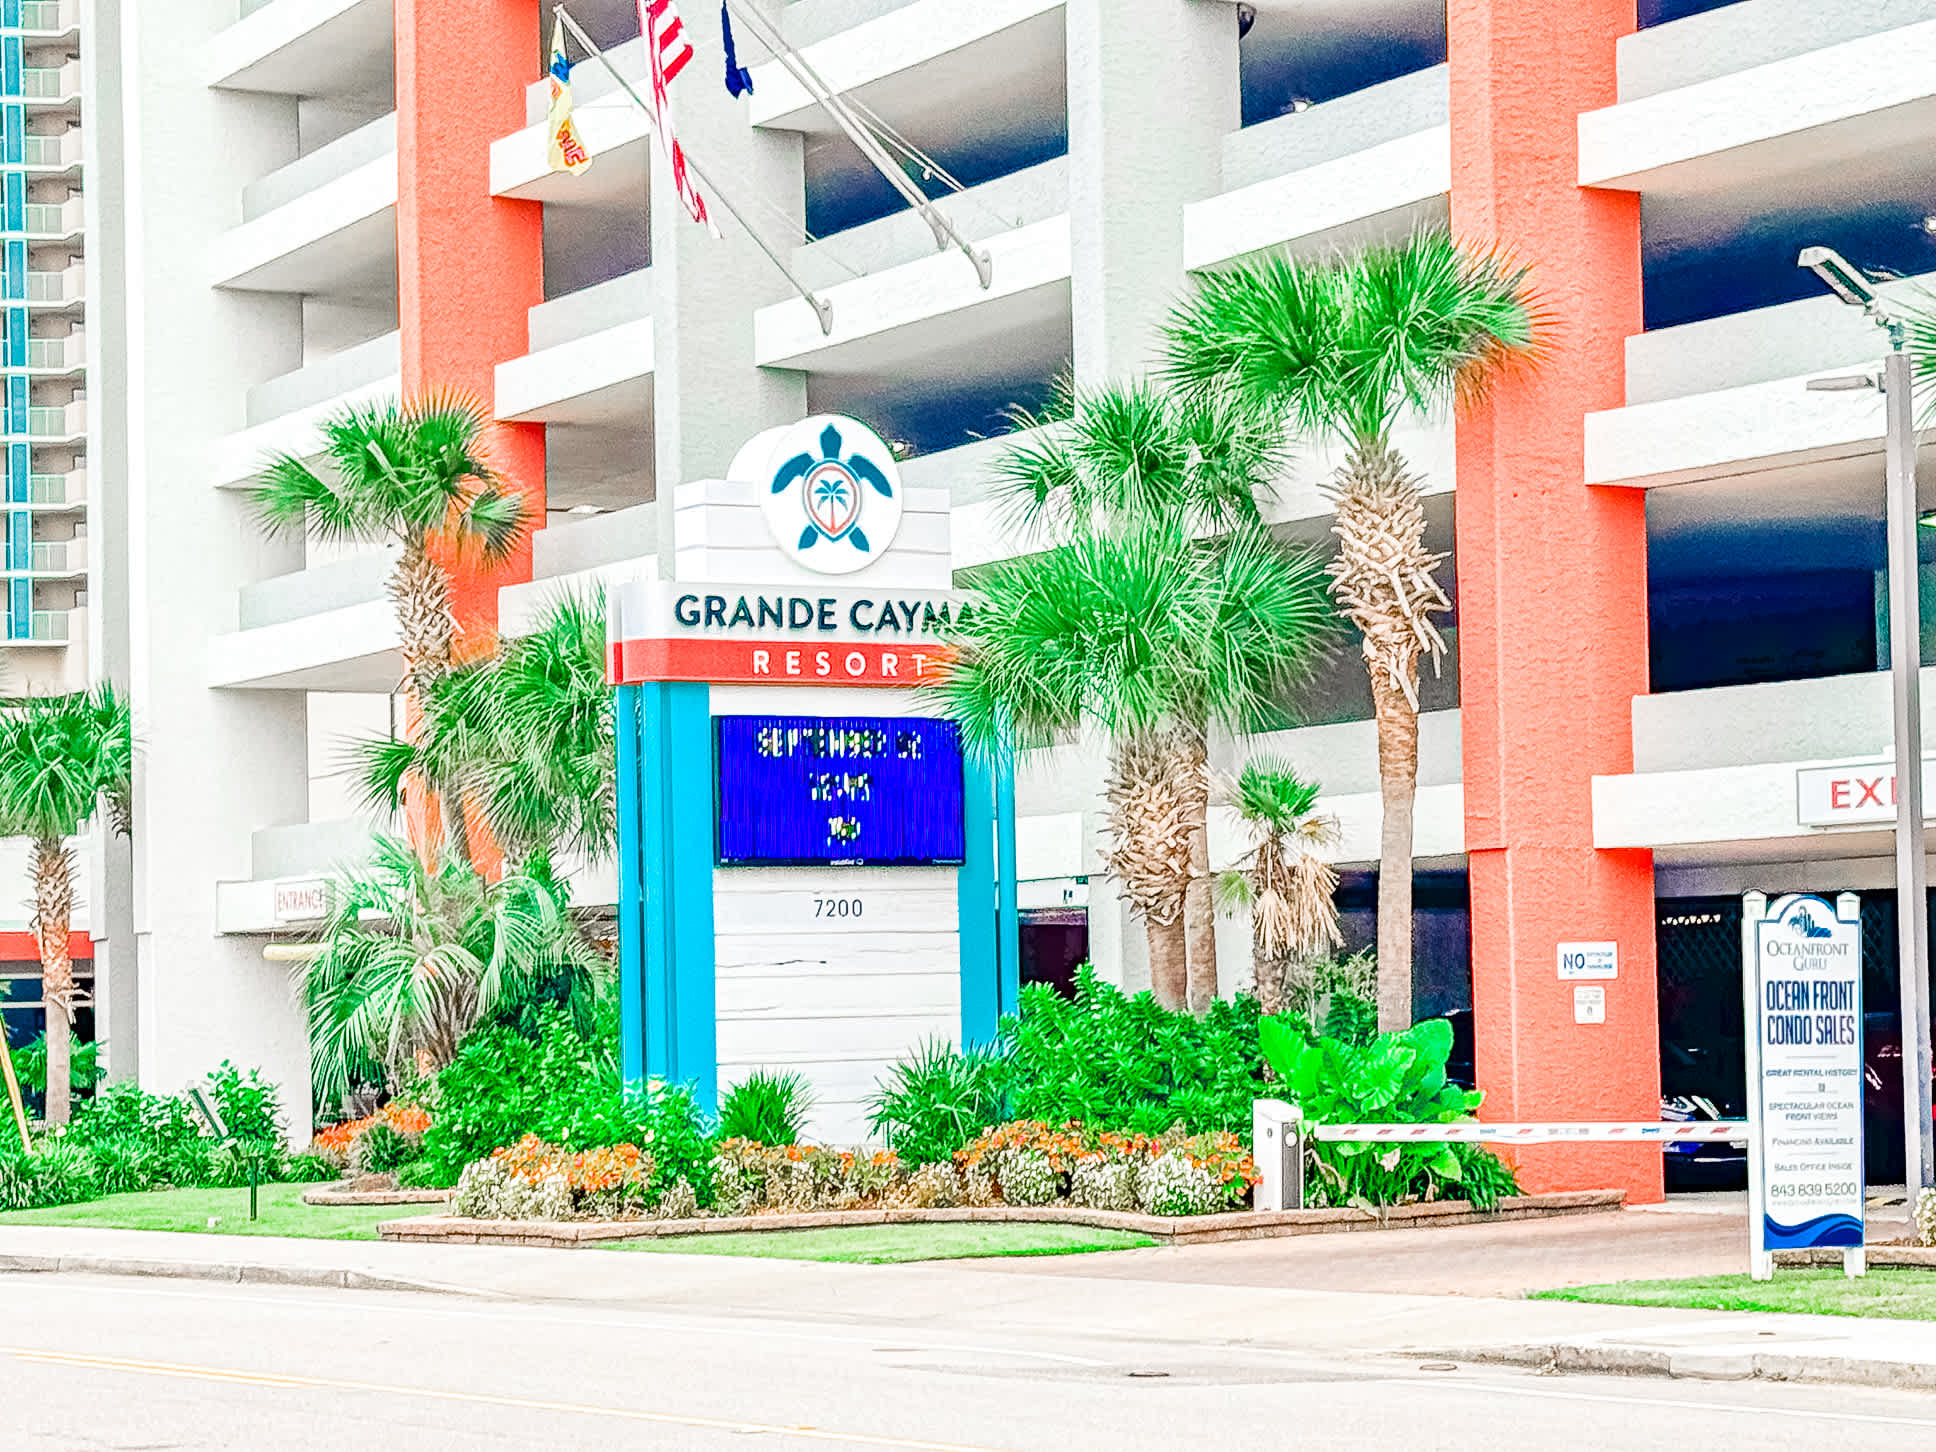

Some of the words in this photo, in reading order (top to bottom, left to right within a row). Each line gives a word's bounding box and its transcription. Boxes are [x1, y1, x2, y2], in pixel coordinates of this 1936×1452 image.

[674, 595, 837, 631] GRANDE
[849, 599, 975, 633] CAYMA
[753, 650, 926, 677] RESORT
[1831, 776, 1897, 809] EXI
[813, 899, 863, 918] 7200
[1563, 953, 1585, 969] NO
[1766, 940, 1849, 957] OCEANFRONT
[1766, 980, 1810, 1011] OCEAN
[1812, 980, 1855, 1011] FRONT
[1767, 1015, 1812, 1045] CONDO
[1815, 1015, 1855, 1045] SALES
[1771, 1184, 1796, 1197] 843
[1798, 1184, 1822, 1197] 839
[1824, 1183, 1857, 1196] 5200
